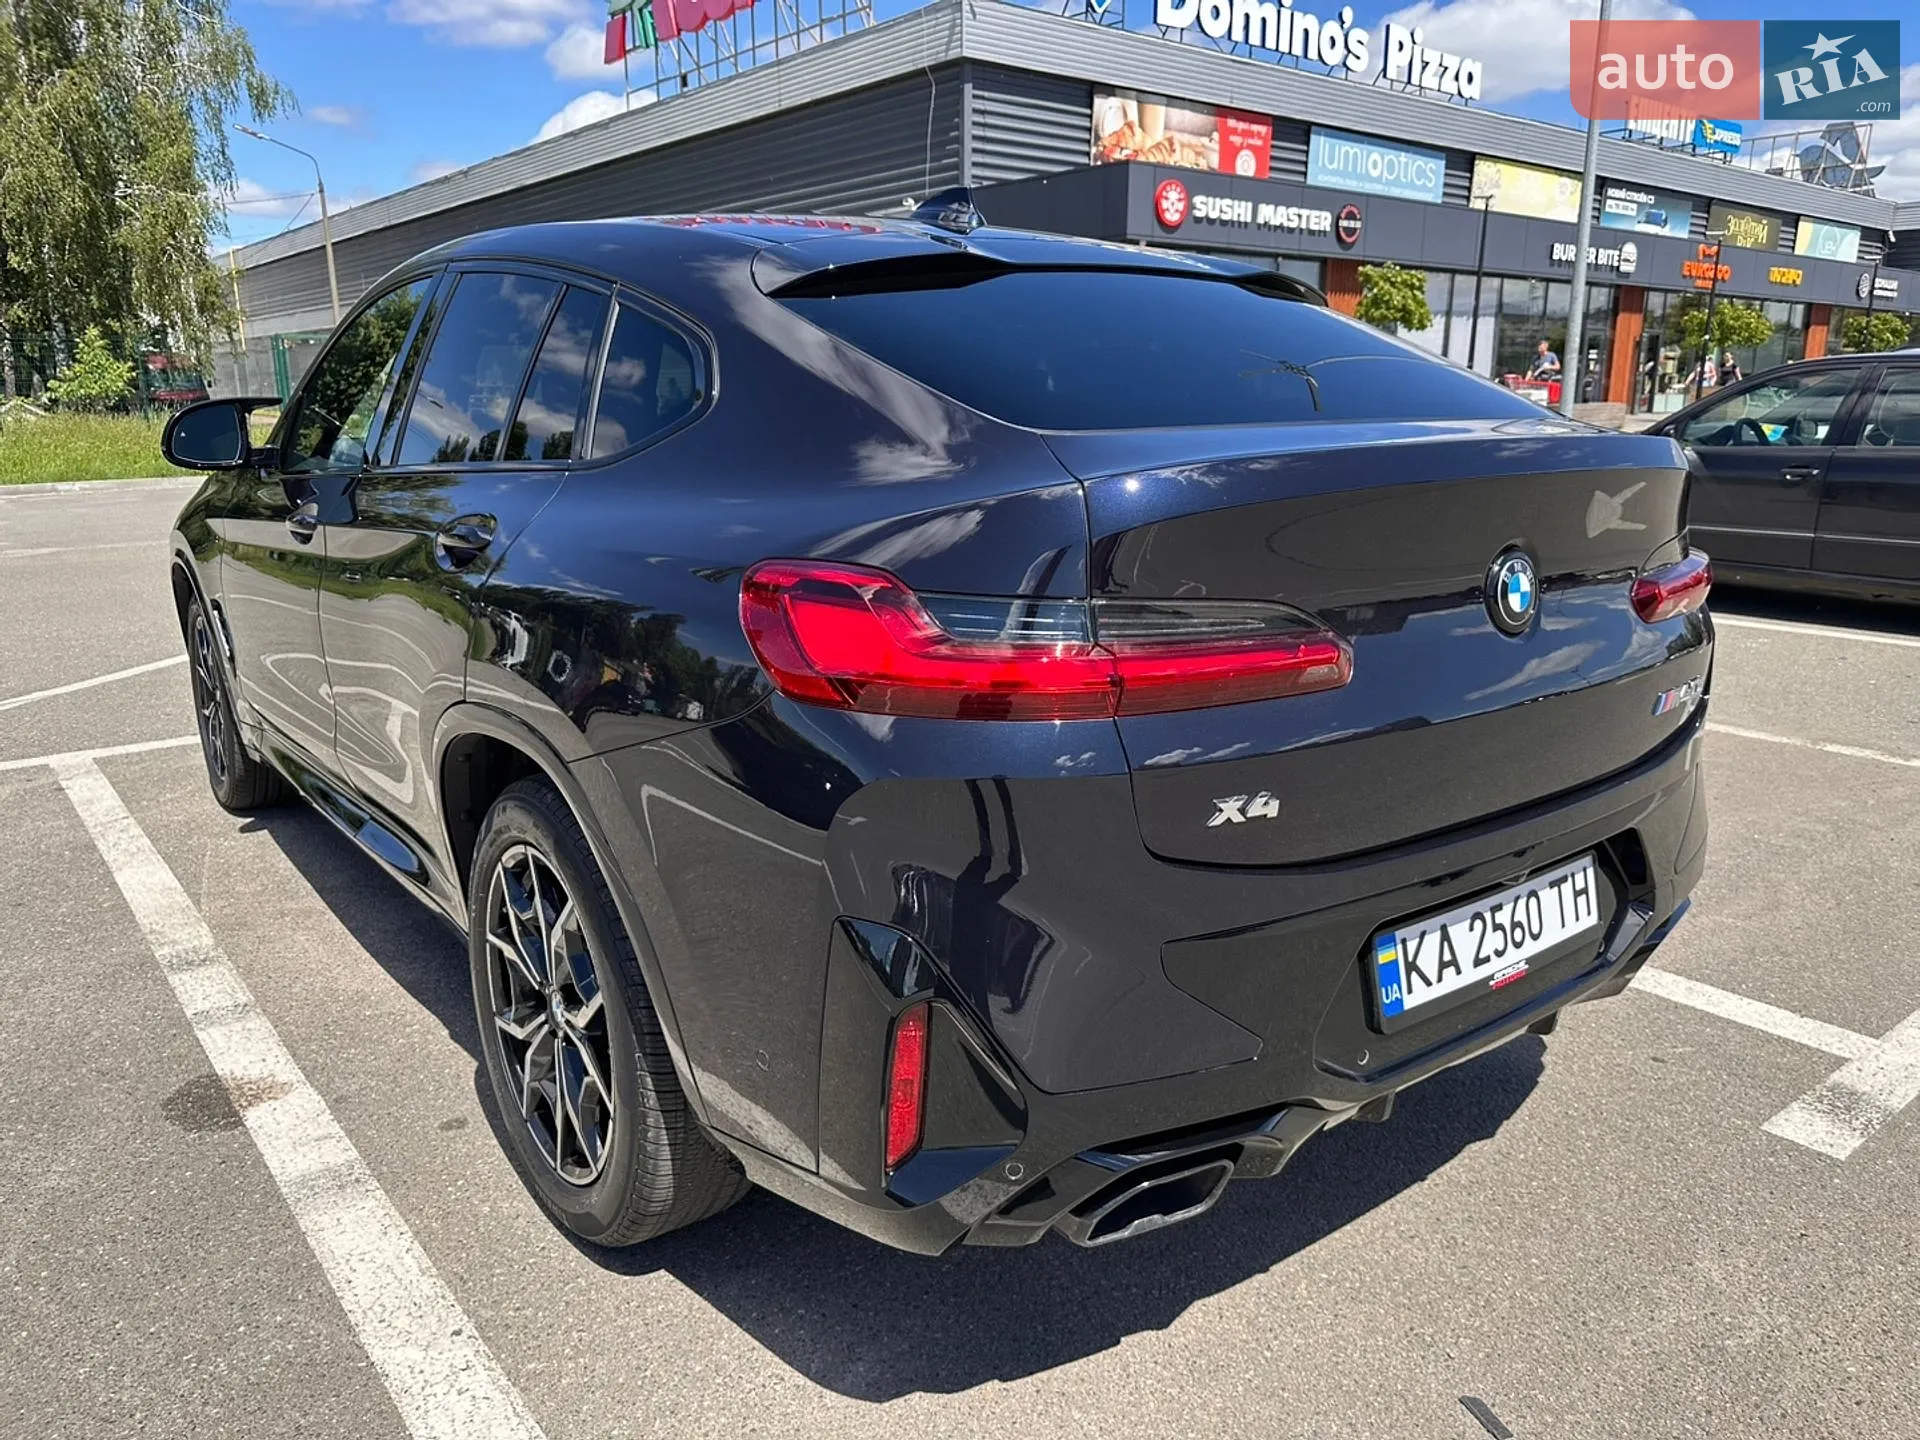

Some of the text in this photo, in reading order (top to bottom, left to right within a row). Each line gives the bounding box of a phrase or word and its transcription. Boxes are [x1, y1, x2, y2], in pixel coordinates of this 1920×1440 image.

[1385, 23, 1482, 100] Pizza
[1318, 132, 1437, 188] lumioptics
[1192, 195, 1252, 224] SUSHI
[1256, 202, 1332, 232] MASTER
[1552, 243, 1620, 266] BURER BITE
[1206, 790, 1281, 828] X4
[1401, 923, 1462, 995] KA
[1468, 889, 1543, 969] 2560
[1548, 866, 1592, 929] TH
[1381, 985, 1401, 1004] UA
